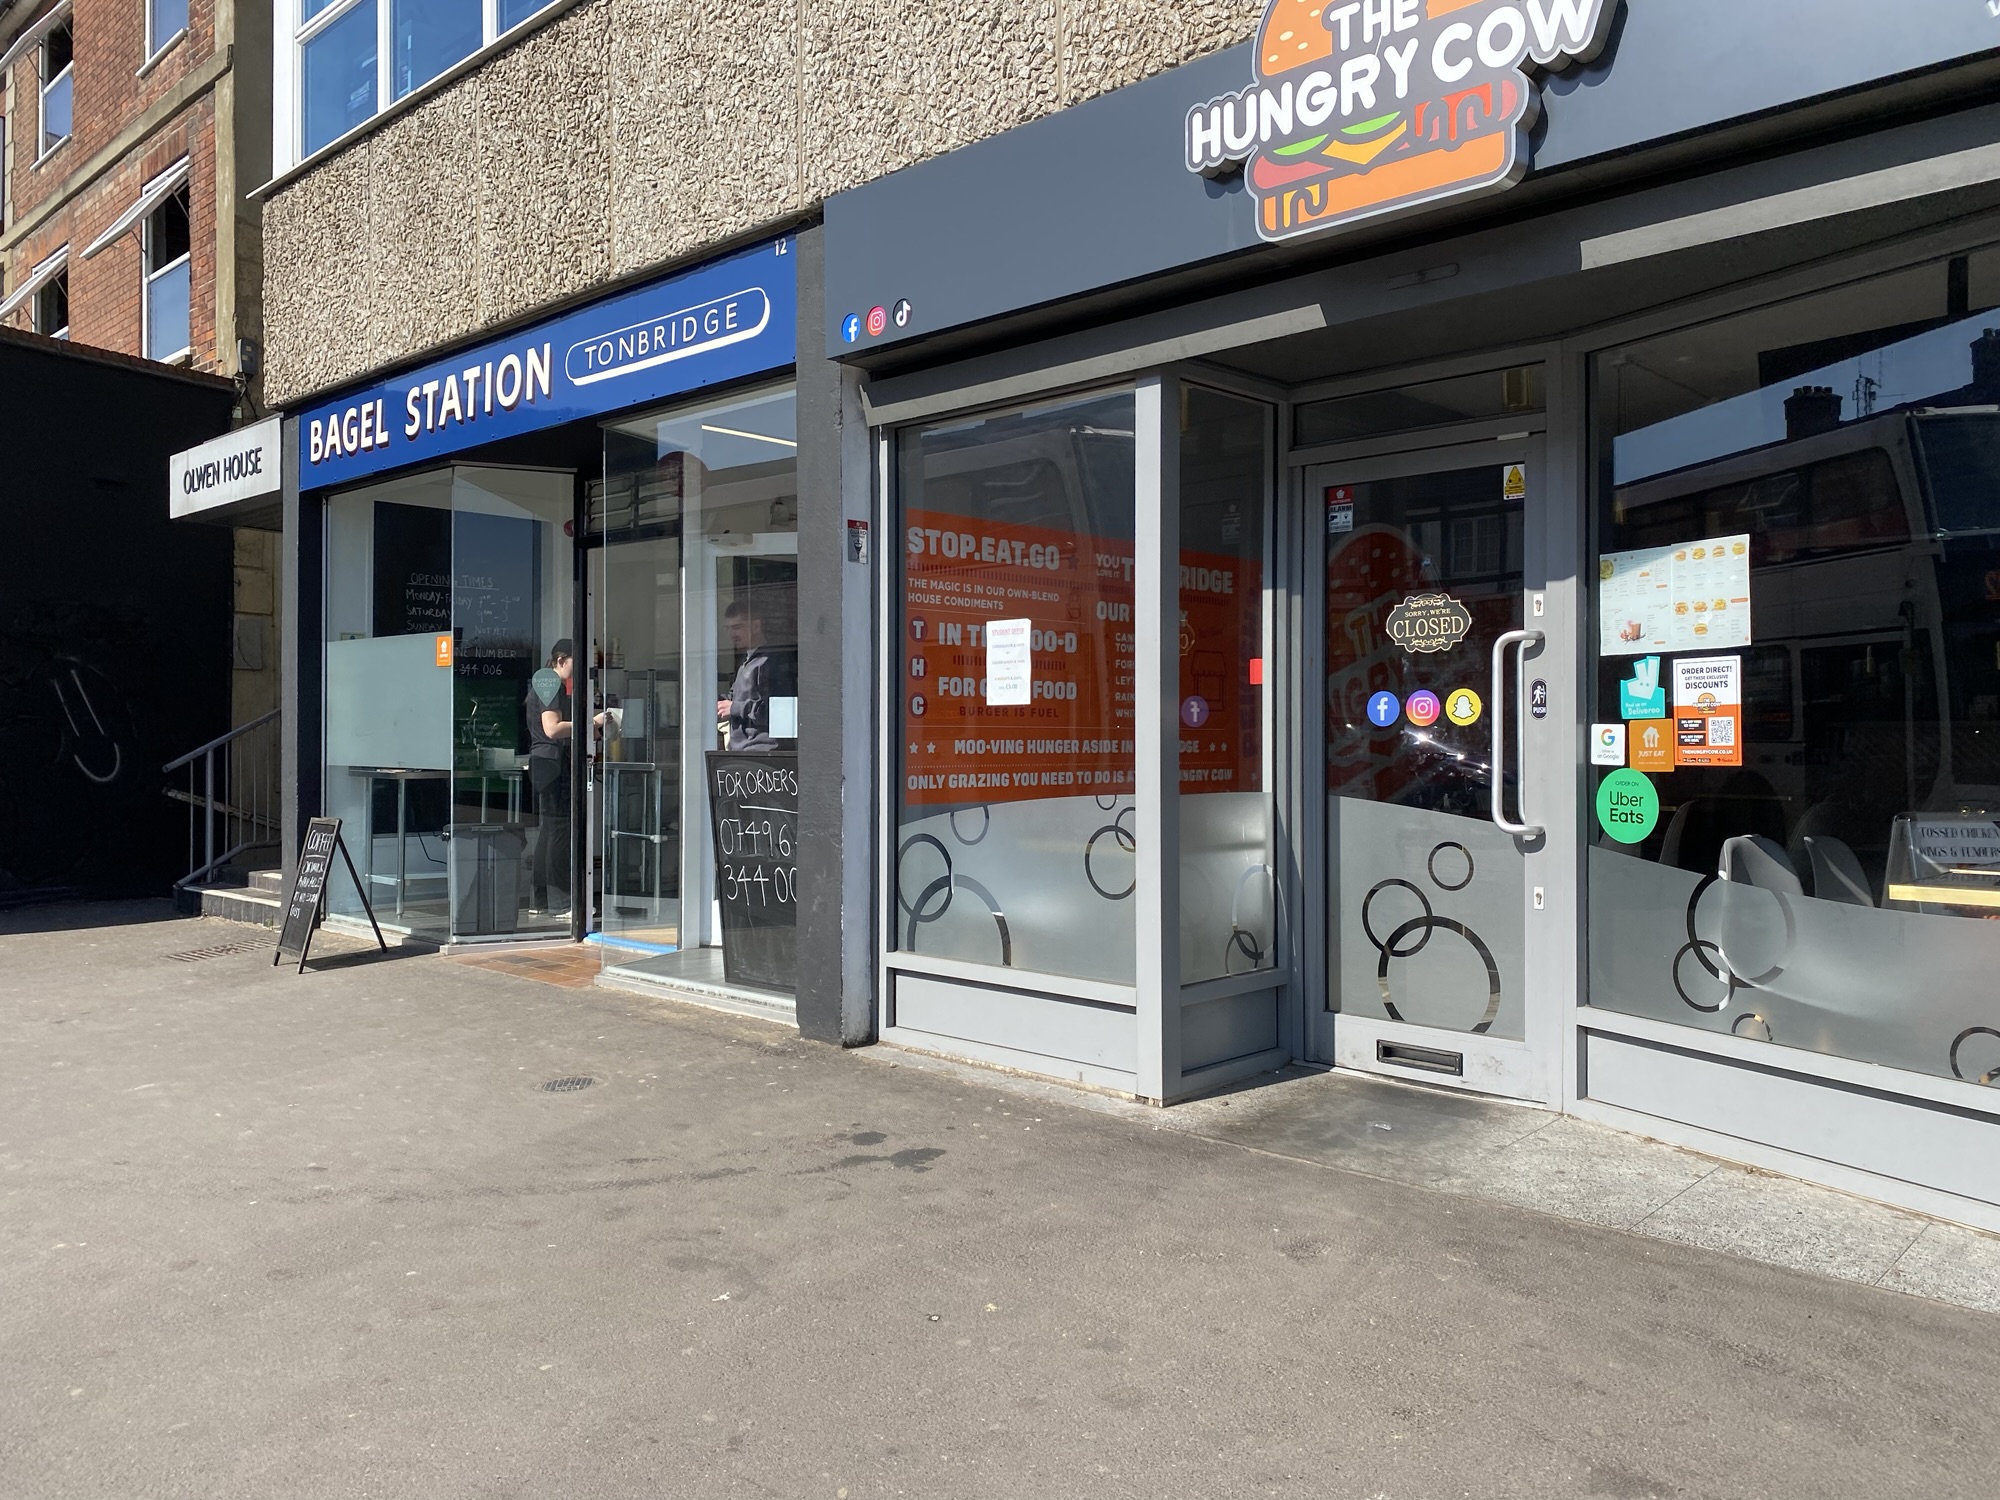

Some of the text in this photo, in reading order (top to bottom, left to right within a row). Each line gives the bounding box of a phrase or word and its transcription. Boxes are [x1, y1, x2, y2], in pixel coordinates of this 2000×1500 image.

[1329, 0, 1420, 51] THE
[1192, 0, 1593, 164] HUNGRY COW
[774, 238, 788, 256] 12
[585, 303, 739, 370] TONBRIDGE
[309, 342, 553, 464] BAGEL STATION
[184, 446, 263, 495] OLWEN HOUSE
[908, 526, 1060, 571] STOP.EAT.GO
[1096, 553, 1120, 569] YOU
[461, 574, 494, 589] TIMES
[908, 577, 1060, 602] THE MAGIC IS IN OUR OWN-BLEND
[908, 592, 1004, 610] HOUSE CONDIMENTS
[1096, 600, 1130, 623] OUR
[913, 620, 925, 639] T
[938, 622, 962, 648] IN
[1393, 615, 1465, 640] CLOSED
[1115, 632, 1134, 642] CAN
[475, 647, 517, 659] NUMBER
[1115, 643, 1134, 653] TOW
[911, 658, 925, 677] H
[1681, 665, 1732, 675] ORDER DIRECT!
[938, 676, 976, 698] FOR
[1033, 680, 1078, 701] FOOD
[1685, 680, 1728, 690] DISCOUNTS
[911, 696, 925, 715] C
[959, 705, 1060, 718] BURGER IS FUEL
[1532, 705, 1548, 714] PUSH
[1628, 707, 1660, 715] Deliveroo
[954, 739, 1134, 755] MOO-VING HUNGER ASIDE IN
[716, 768, 798, 799] FOR ORDERS
[907, 774, 946, 790] ONLY
[948, 773, 1010, 789] GRAZING
[1013, 772, 1038, 787] YOU
[1041, 771, 1074, 786] NEED
[1076, 771, 1092, 785] TO
[1094, 771, 1111, 784] DO
[1113, 771, 1124, 783] IS
[1211, 768, 1233, 781] COW
[1609, 790, 1644, 807] Uber
[1609, 807, 1645, 824] Eats
[1920, 827, 1959, 838] TOSSED
[1919, 846, 1948, 858] WINGS
[724, 864, 770, 907] 344
